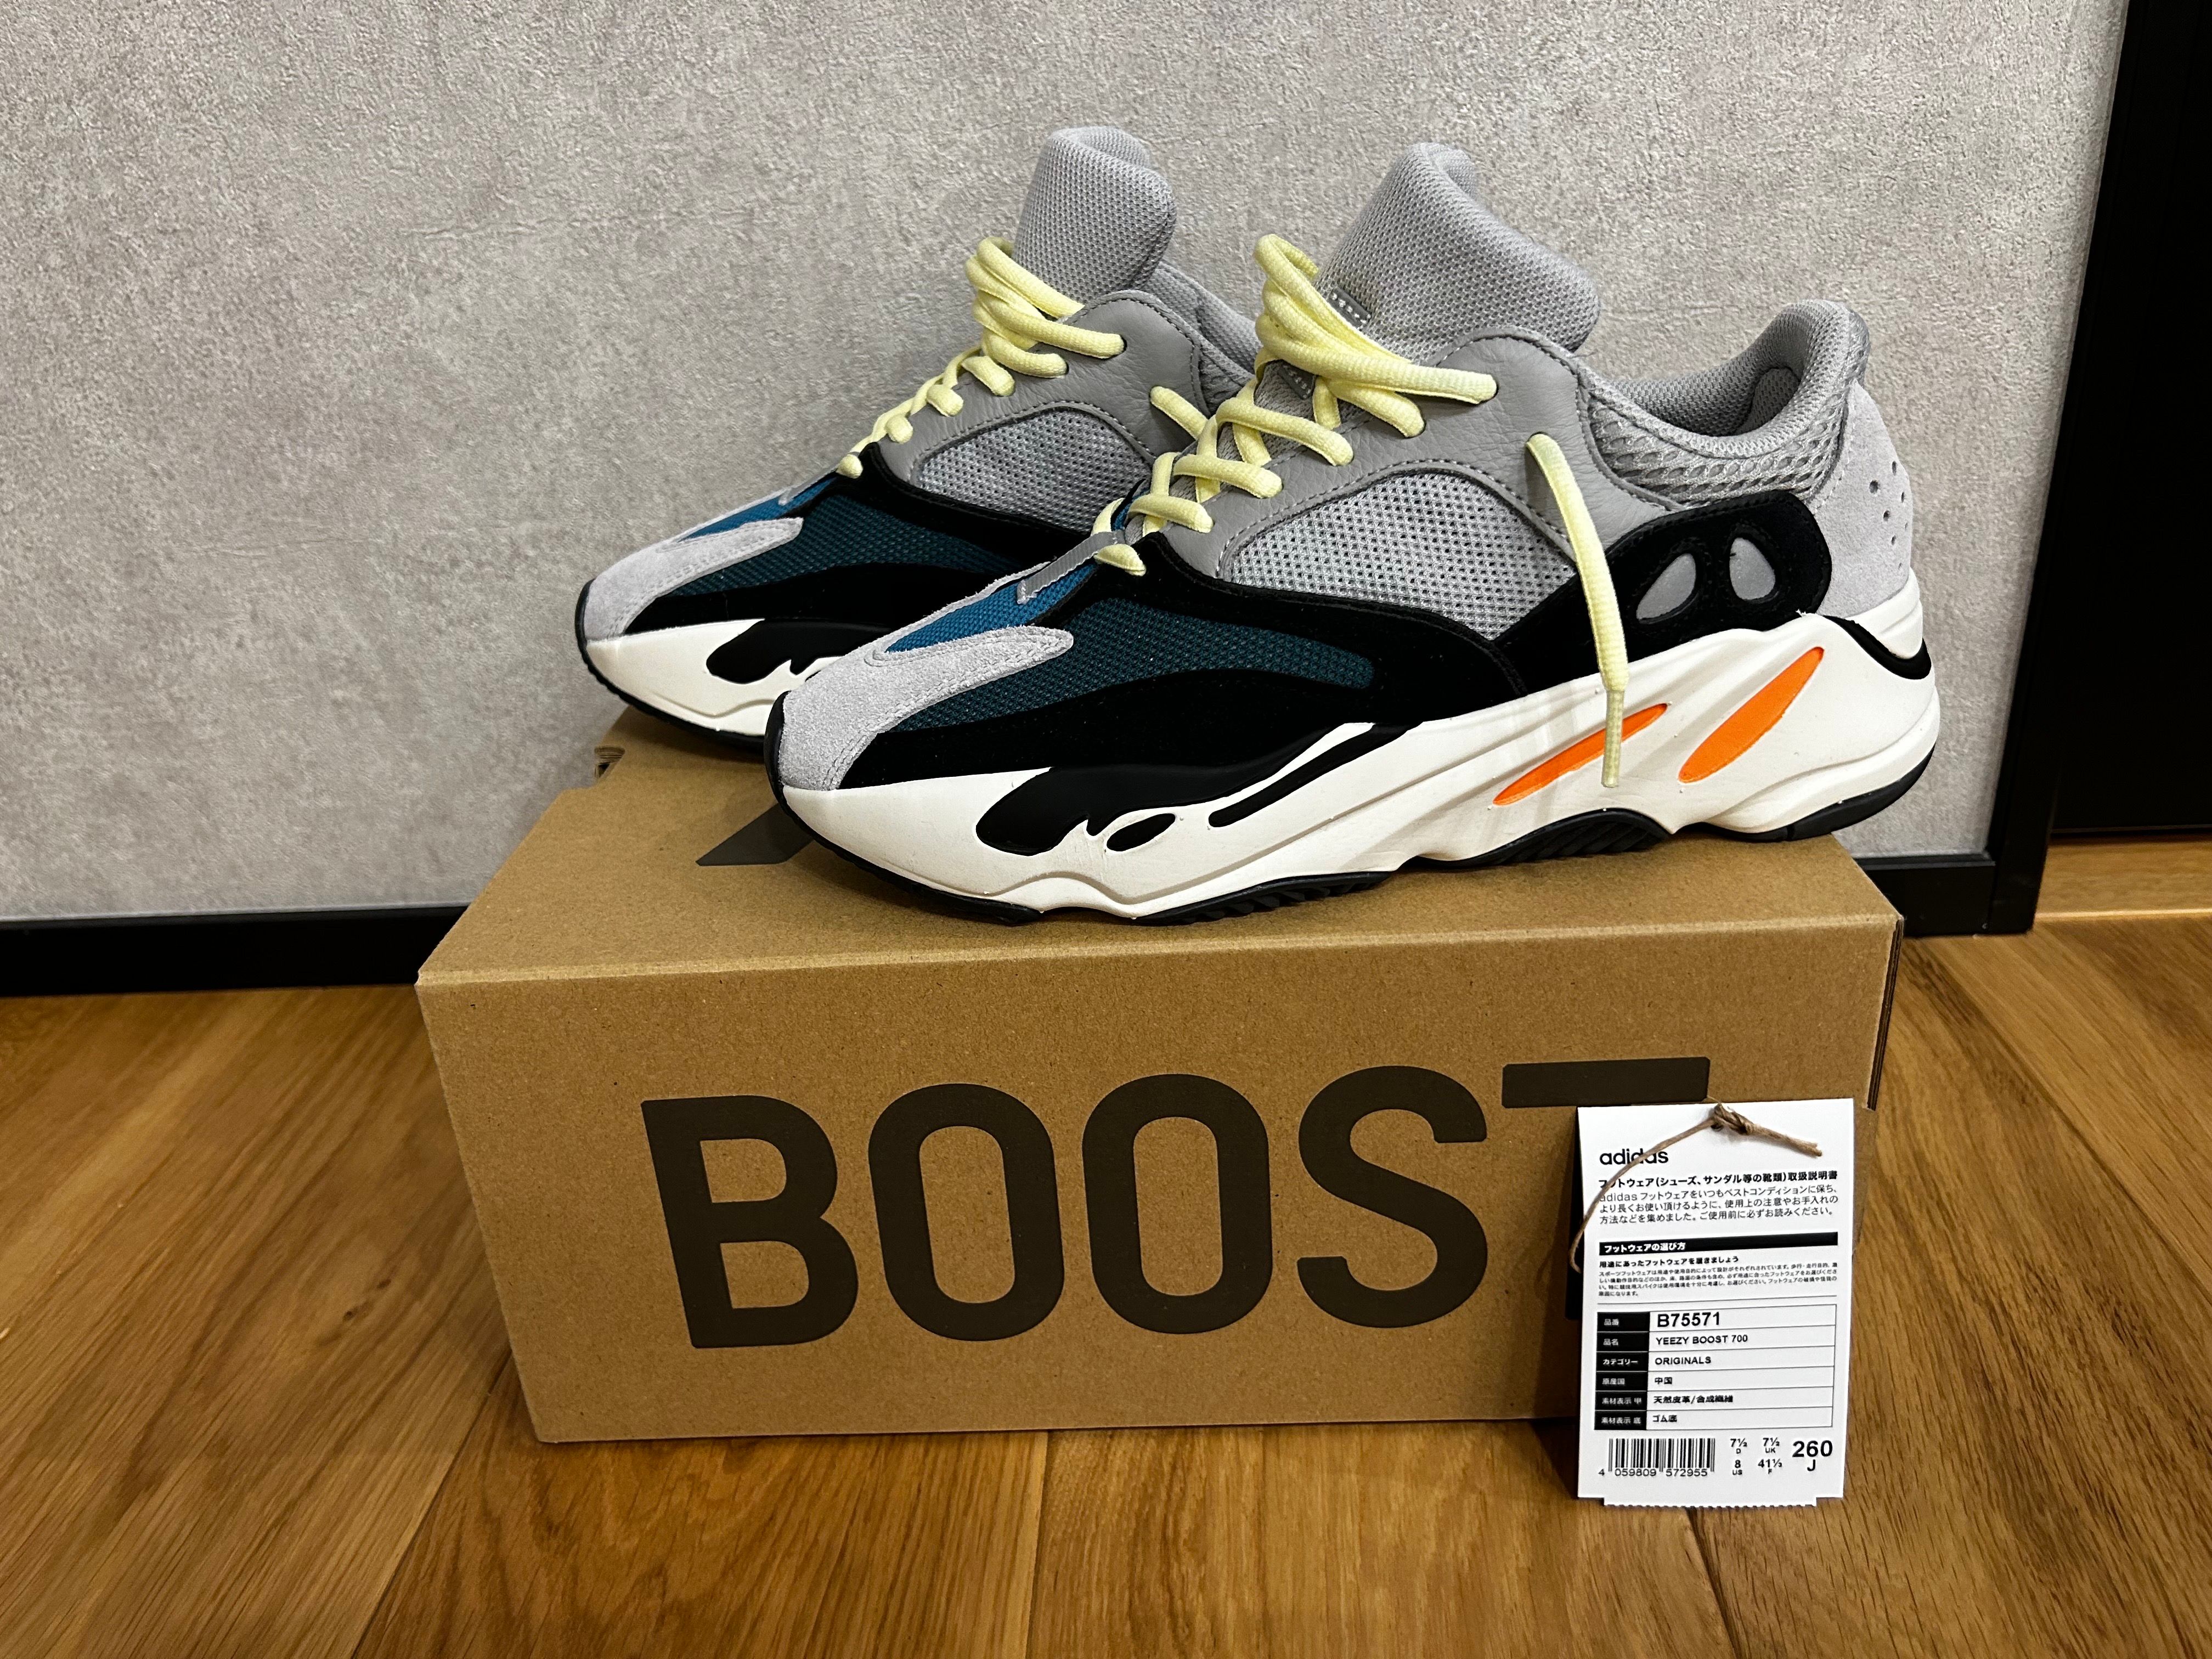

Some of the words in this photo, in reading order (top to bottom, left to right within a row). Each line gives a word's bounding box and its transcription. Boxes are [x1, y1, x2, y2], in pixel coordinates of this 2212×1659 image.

[1600, 1148, 1669, 1165] adidas
[1600, 1193, 1638, 1202] adidas
[1600, 1195, 1838, 1213] より長くお使い頂けるように、使用上の注意やお手入れの
[1600, 1207, 1832, 1224] 方法などを集めました。ご使用前に必ずお読みください。
[1604, 1242, 1686, 1253] フットウェアの選び方
[1657, 1312, 1720, 1327] B75571
[1656, 1336, 1689, 1345] YEEZY
[1692, 1335, 1728, 1344] BOOST
[1731, 1334, 1748, 1342] 700
[1655, 1356, 1711, 1365] ORIGINALS
[1655, 1376, 1673, 1385] 中国
[1652, 1414, 1678, 1423] ゴム底
[1792, 1440, 1833, 1458] 260
[1735, 1459, 1741, 1468] 8
[1807, 1459, 1816, 1471] J
[1615, 1468, 1657, 1477] 059809
[1666, 1468, 1708, 1477] 572955
